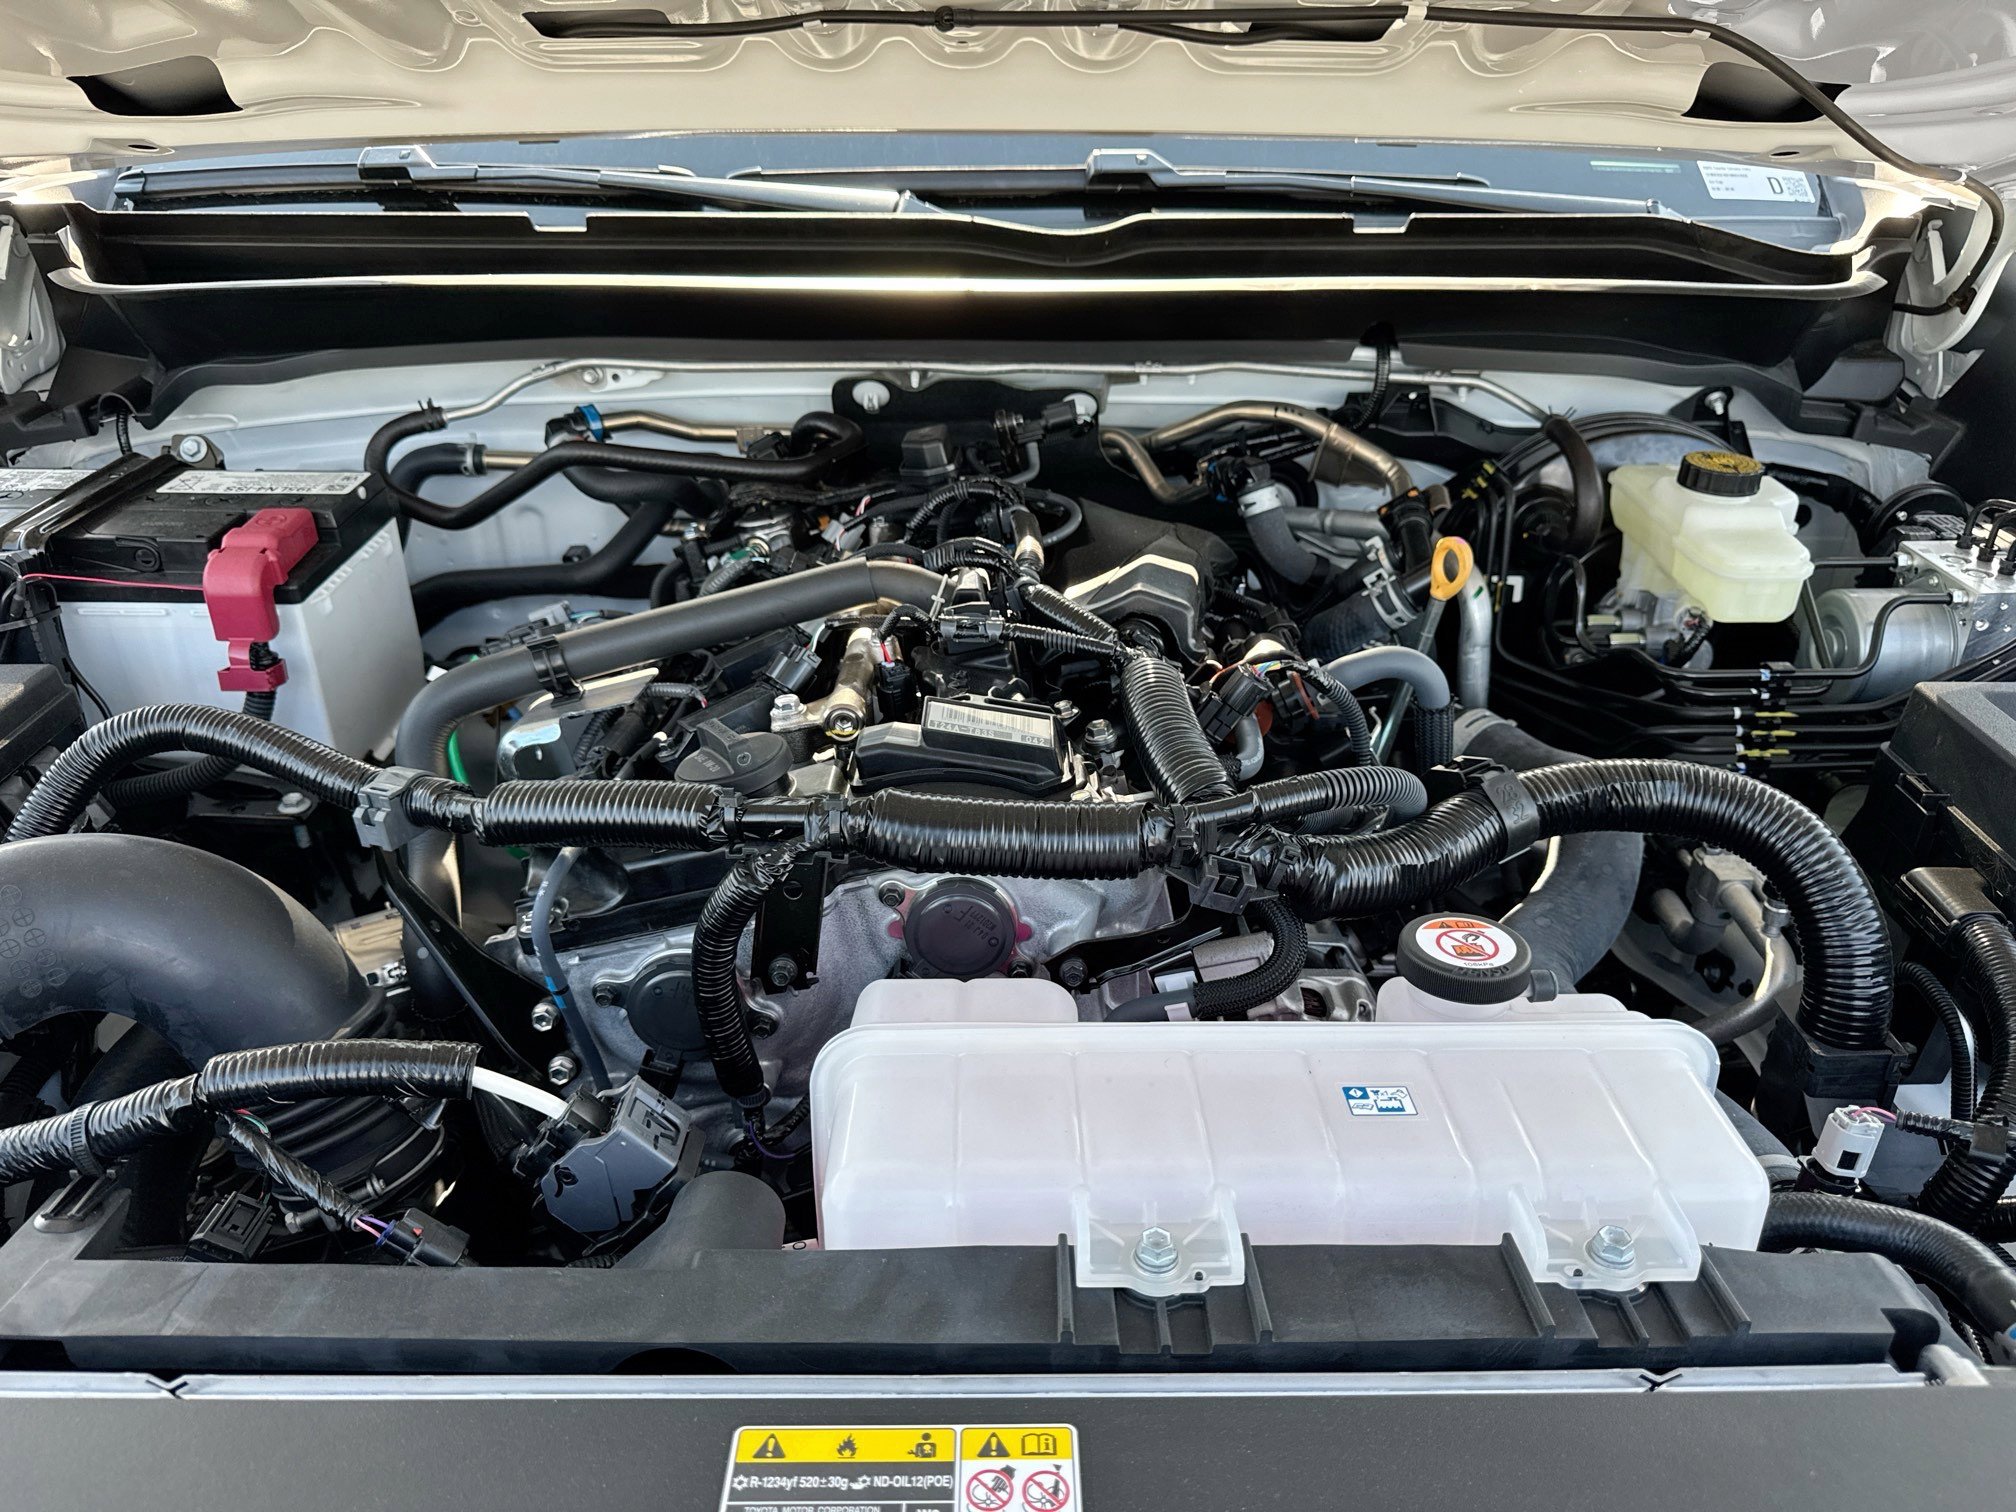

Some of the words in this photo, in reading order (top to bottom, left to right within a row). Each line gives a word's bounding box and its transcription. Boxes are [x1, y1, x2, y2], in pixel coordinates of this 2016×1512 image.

[1767, 177, 1784, 195] D
[1026, 735, 1045, 746] 042
[750, 1476, 797, 1490] R-1234yf
[799, 1476, 848, 1490] 520±30g
[873, 1475, 953, 1489] ND-OIL12(POE)
